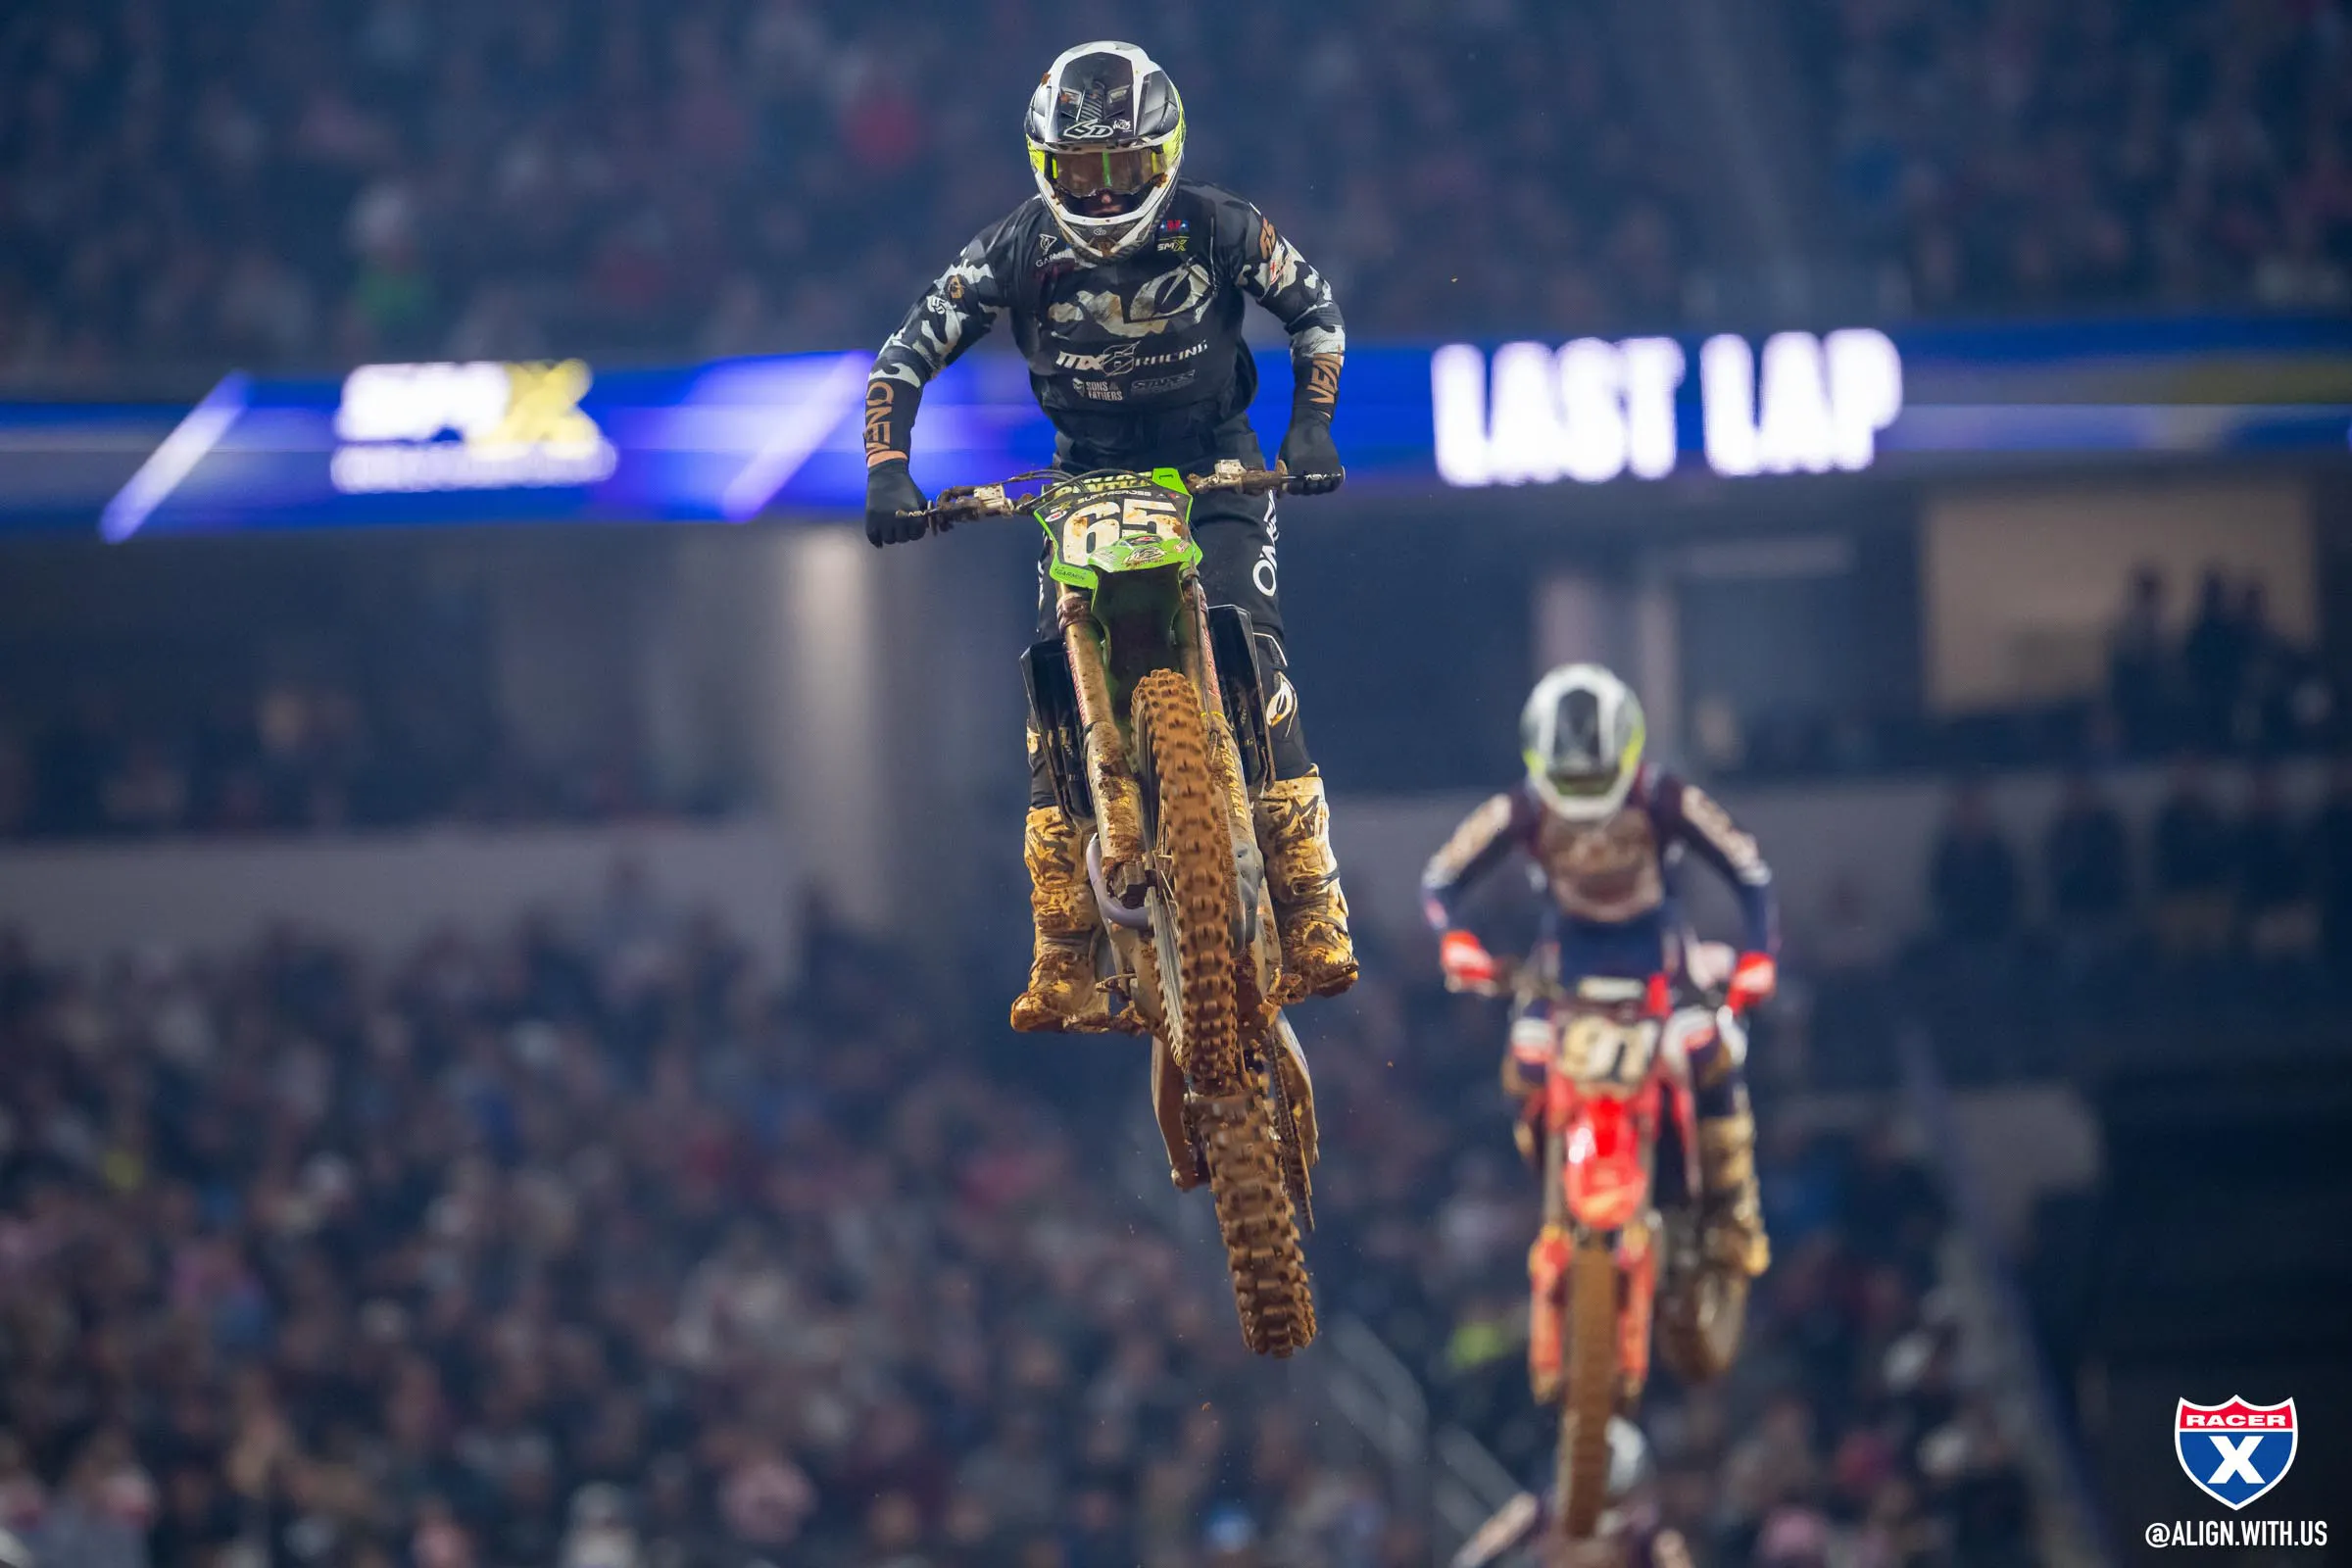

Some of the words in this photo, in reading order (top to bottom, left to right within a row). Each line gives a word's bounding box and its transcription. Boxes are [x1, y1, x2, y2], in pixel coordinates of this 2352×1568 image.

[1156, 239, 1188, 252] SMX
[1086, 381, 1108, 392] SONS
[1431, 337, 1687, 486] LAST
[1700, 328, 1903, 476] LAP
[1063, 499, 1182, 567] 65
